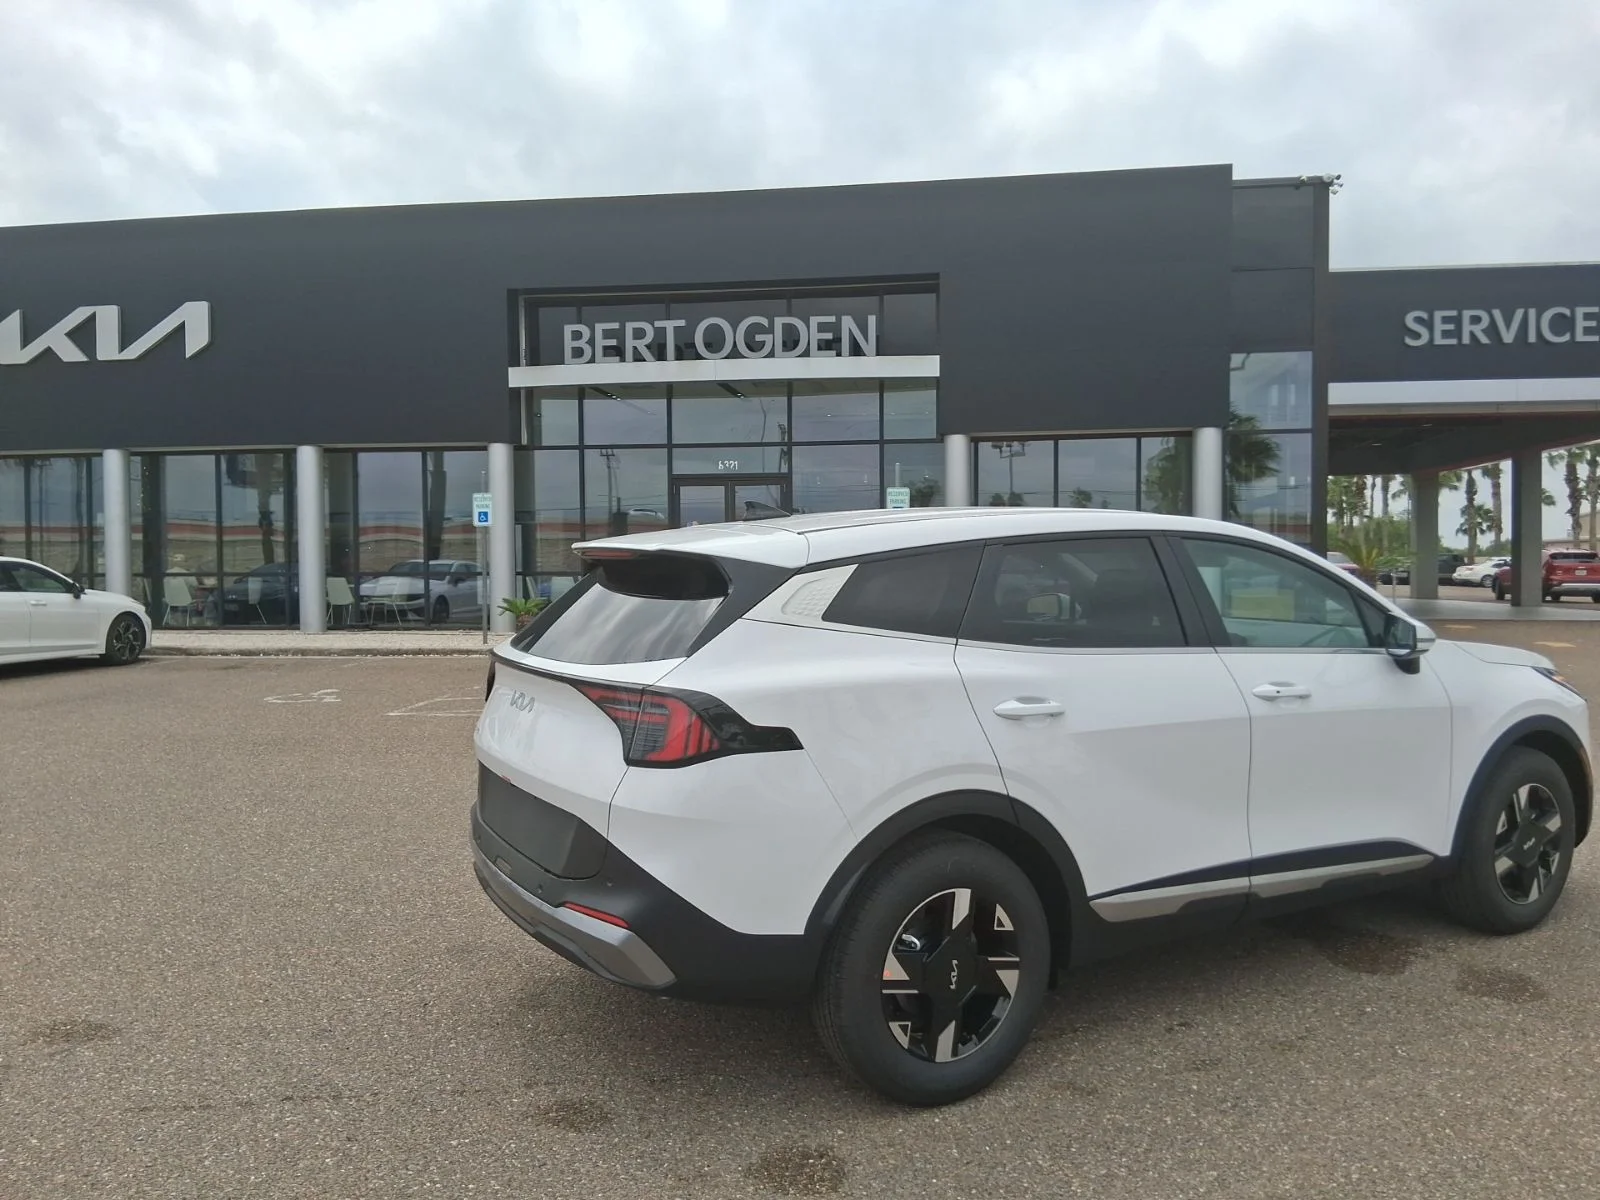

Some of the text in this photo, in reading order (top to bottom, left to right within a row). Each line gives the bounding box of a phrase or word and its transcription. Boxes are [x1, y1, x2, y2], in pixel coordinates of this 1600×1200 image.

[0, 301, 211, 365] KIA
[563, 314, 877, 364] BERT OGDEN
[1404, 306, 1600, 347] SERVICE
[510, 690, 535, 713] KIA
